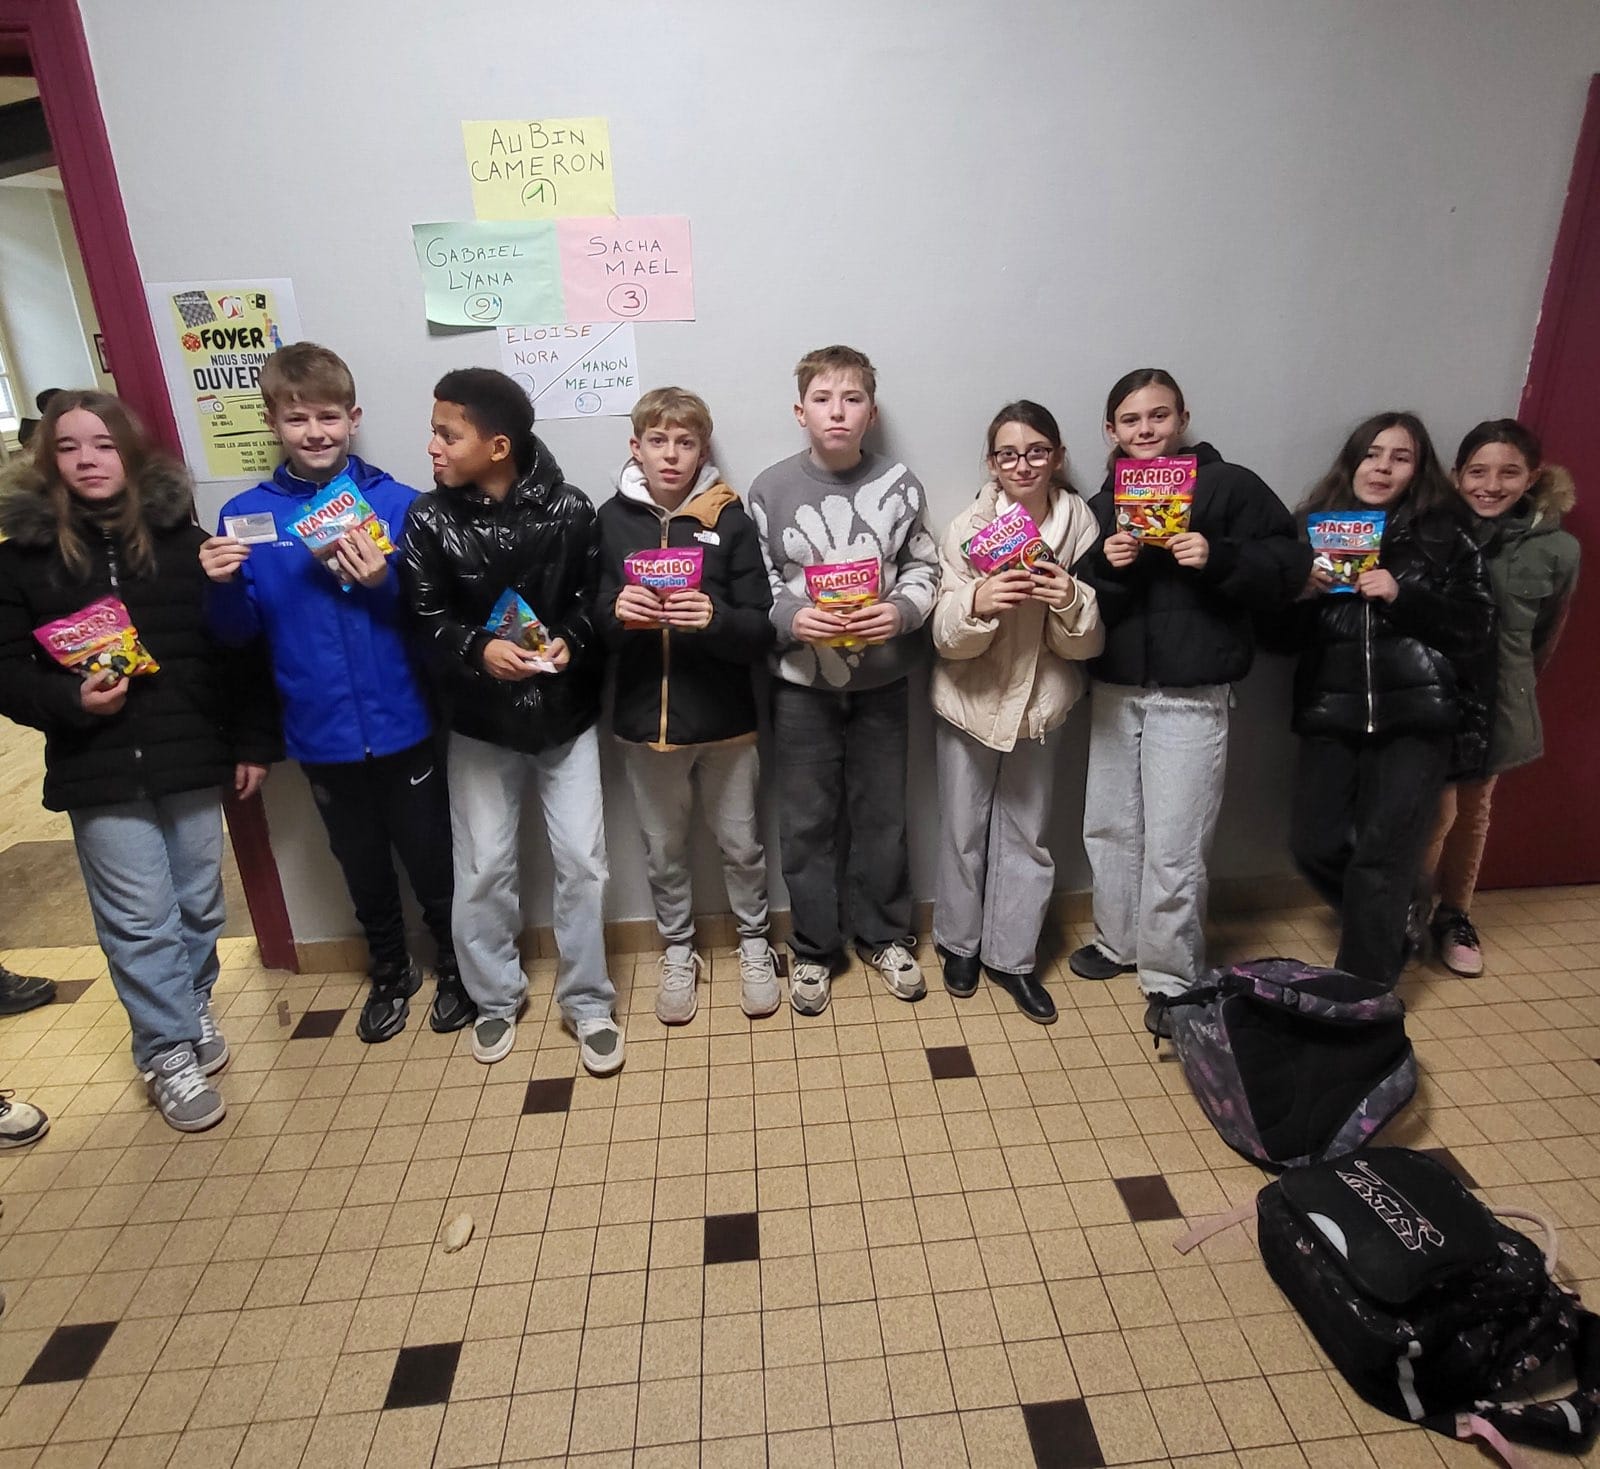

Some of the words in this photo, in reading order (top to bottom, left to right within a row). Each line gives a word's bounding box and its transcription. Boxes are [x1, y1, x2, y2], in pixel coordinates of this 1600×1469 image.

[490, 123, 585, 156] AUBIN
[471, 151, 605, 182] CAMERON
[426, 237, 524, 267] GABRIEL
[587, 236, 662, 257] SACHA
[605, 259, 679, 277] MAEL
[449, 270, 514, 290] LYANA
[622, 290, 640, 309] 3
[201, 327, 265, 350] FOYER
[506, 325, 592, 344] ELOISE
[210, 353, 238, 366] NOUS
[240, 352, 271, 365] SOMM
[514, 350, 559, 366] NORA
[582, 357, 628, 374] MANON
[193, 366, 261, 390] OUVER
[565, 375, 634, 390] MELINE
[1121, 468, 1185, 485] HARIBO
[1127, 486, 1155, 497] Happy
[295, 492, 356, 538] HARIBO
[1316, 521, 1375, 534] HARIBO
[632, 559, 694, 575] HARIBO
[641, 576, 687, 588] Dragibus
[812, 570, 870, 589] HARIBO
